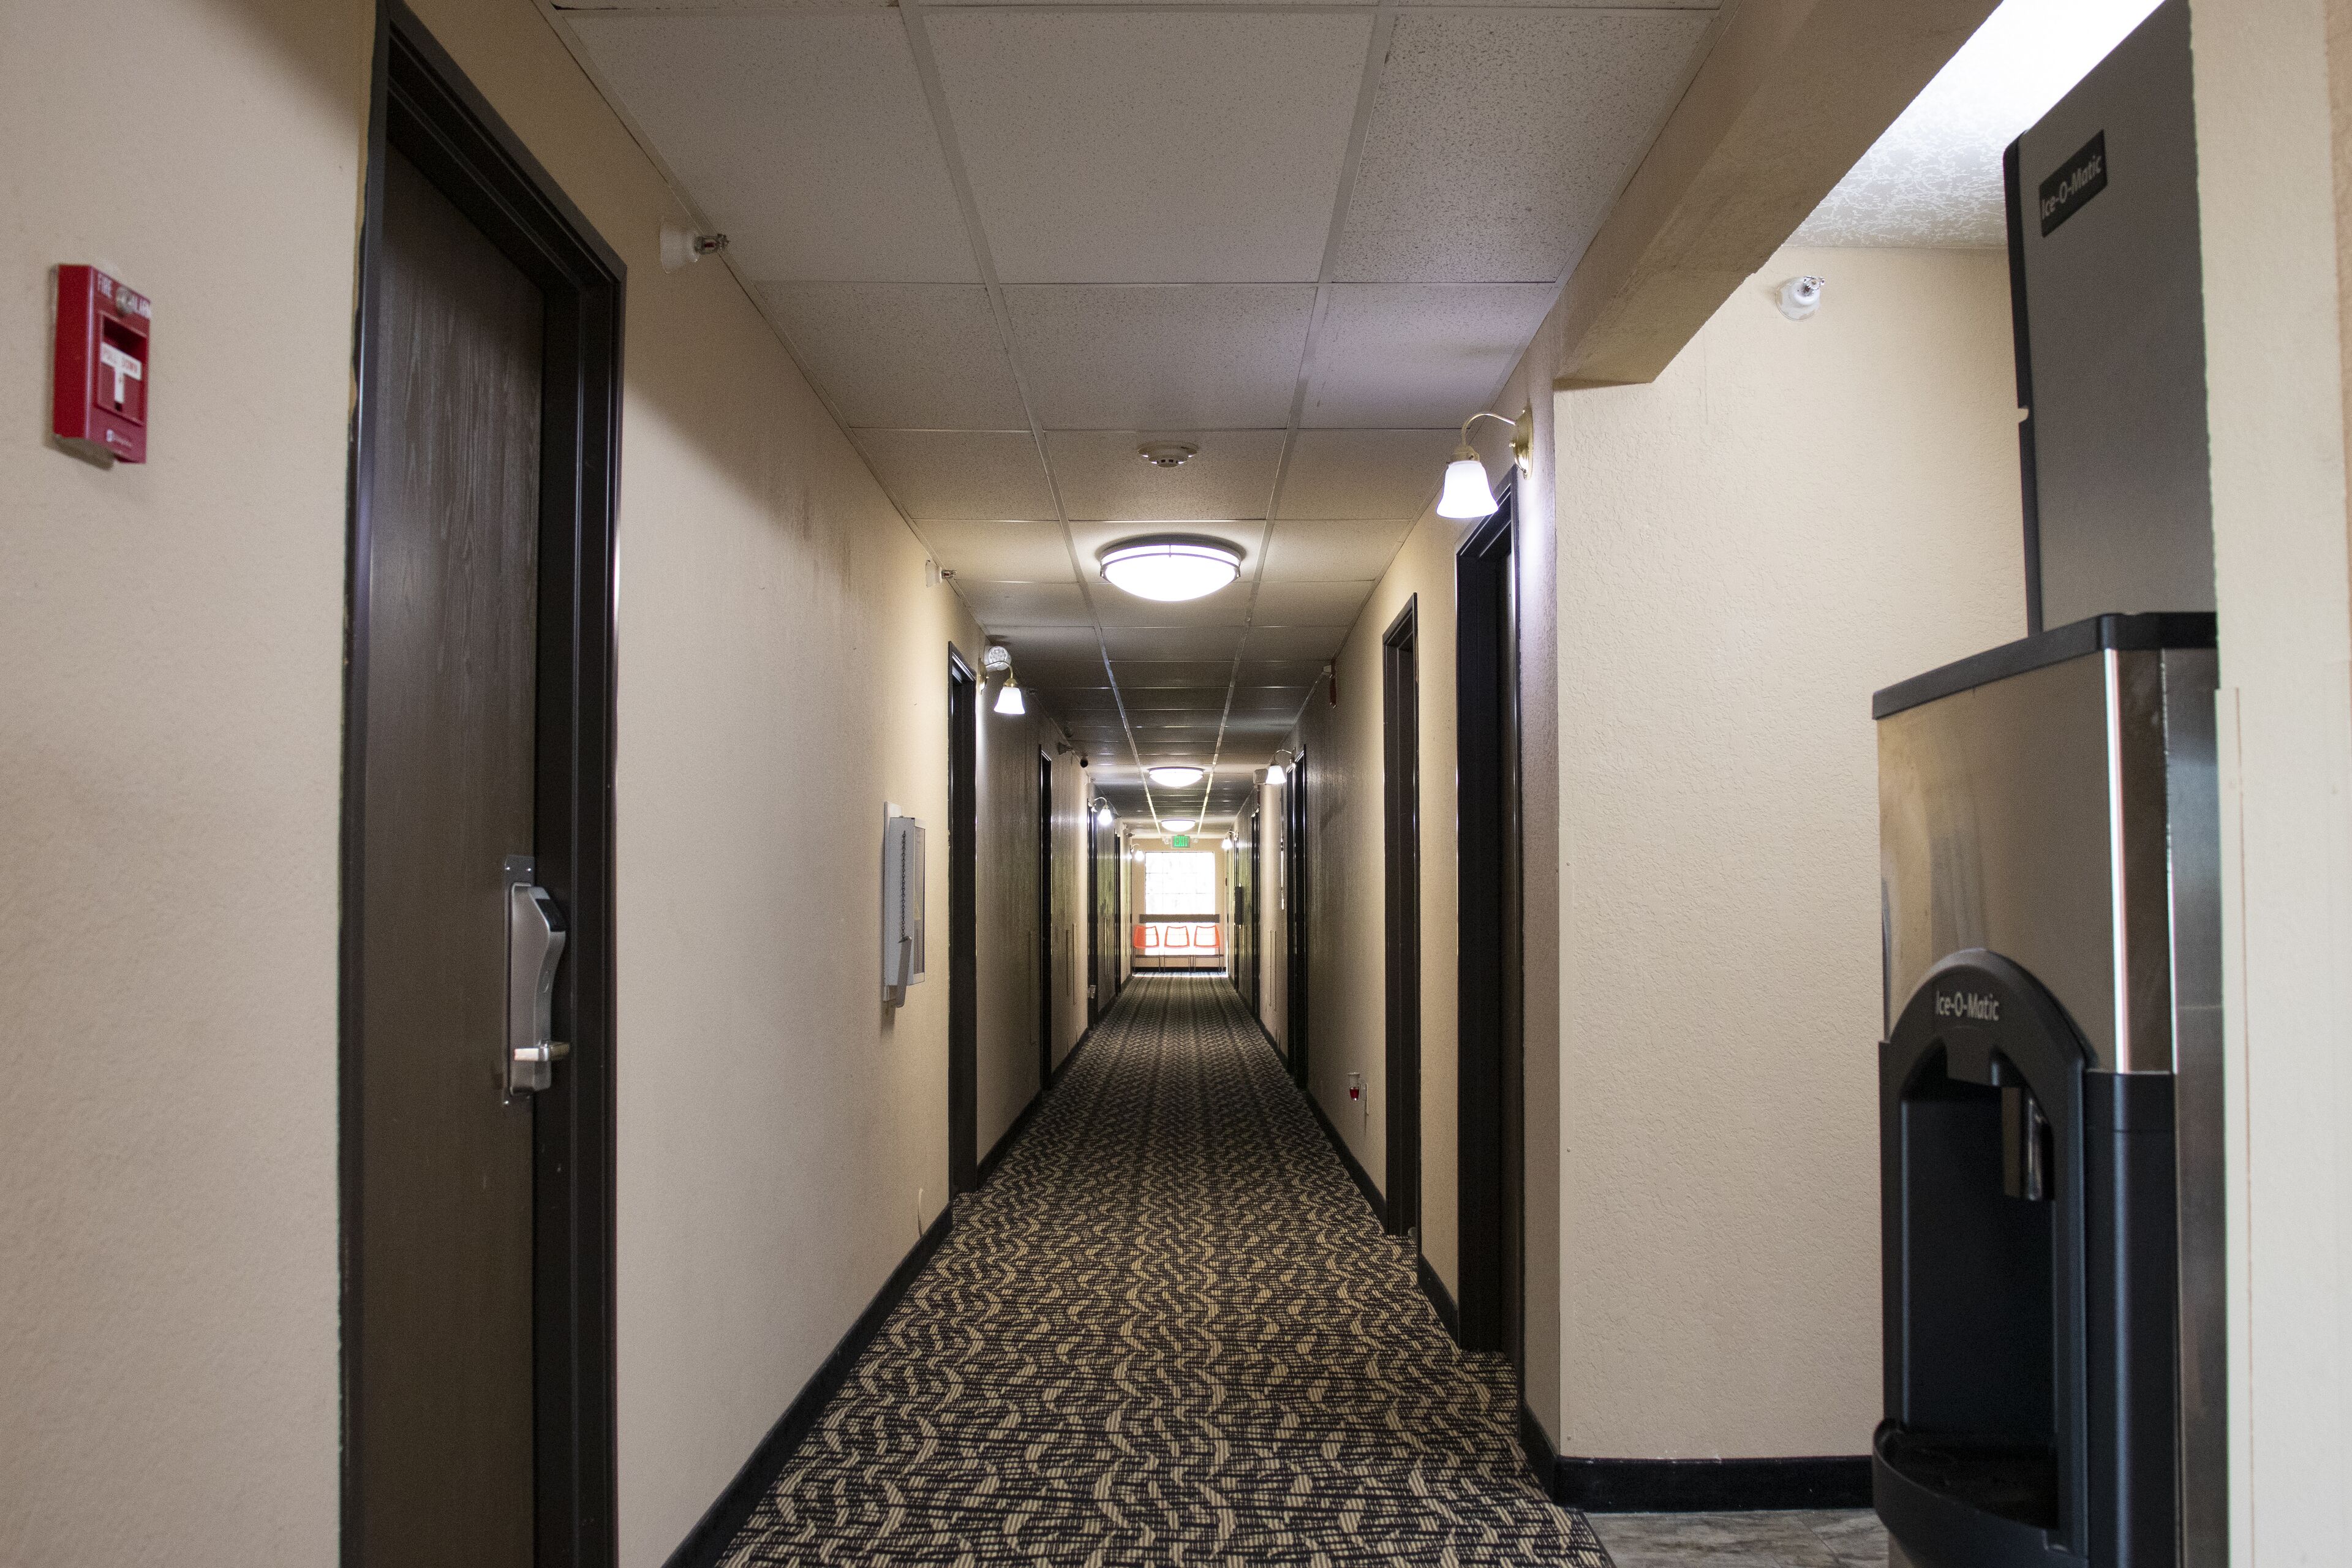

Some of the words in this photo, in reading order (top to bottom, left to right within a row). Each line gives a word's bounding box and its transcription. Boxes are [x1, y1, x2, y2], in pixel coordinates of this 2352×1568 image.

[2041, 155, 2102, 219] Ice-O-Matic
[1174, 835, 1188, 846] EXIT
[1936, 990, 2000, 1022] Ice-O-Matic
